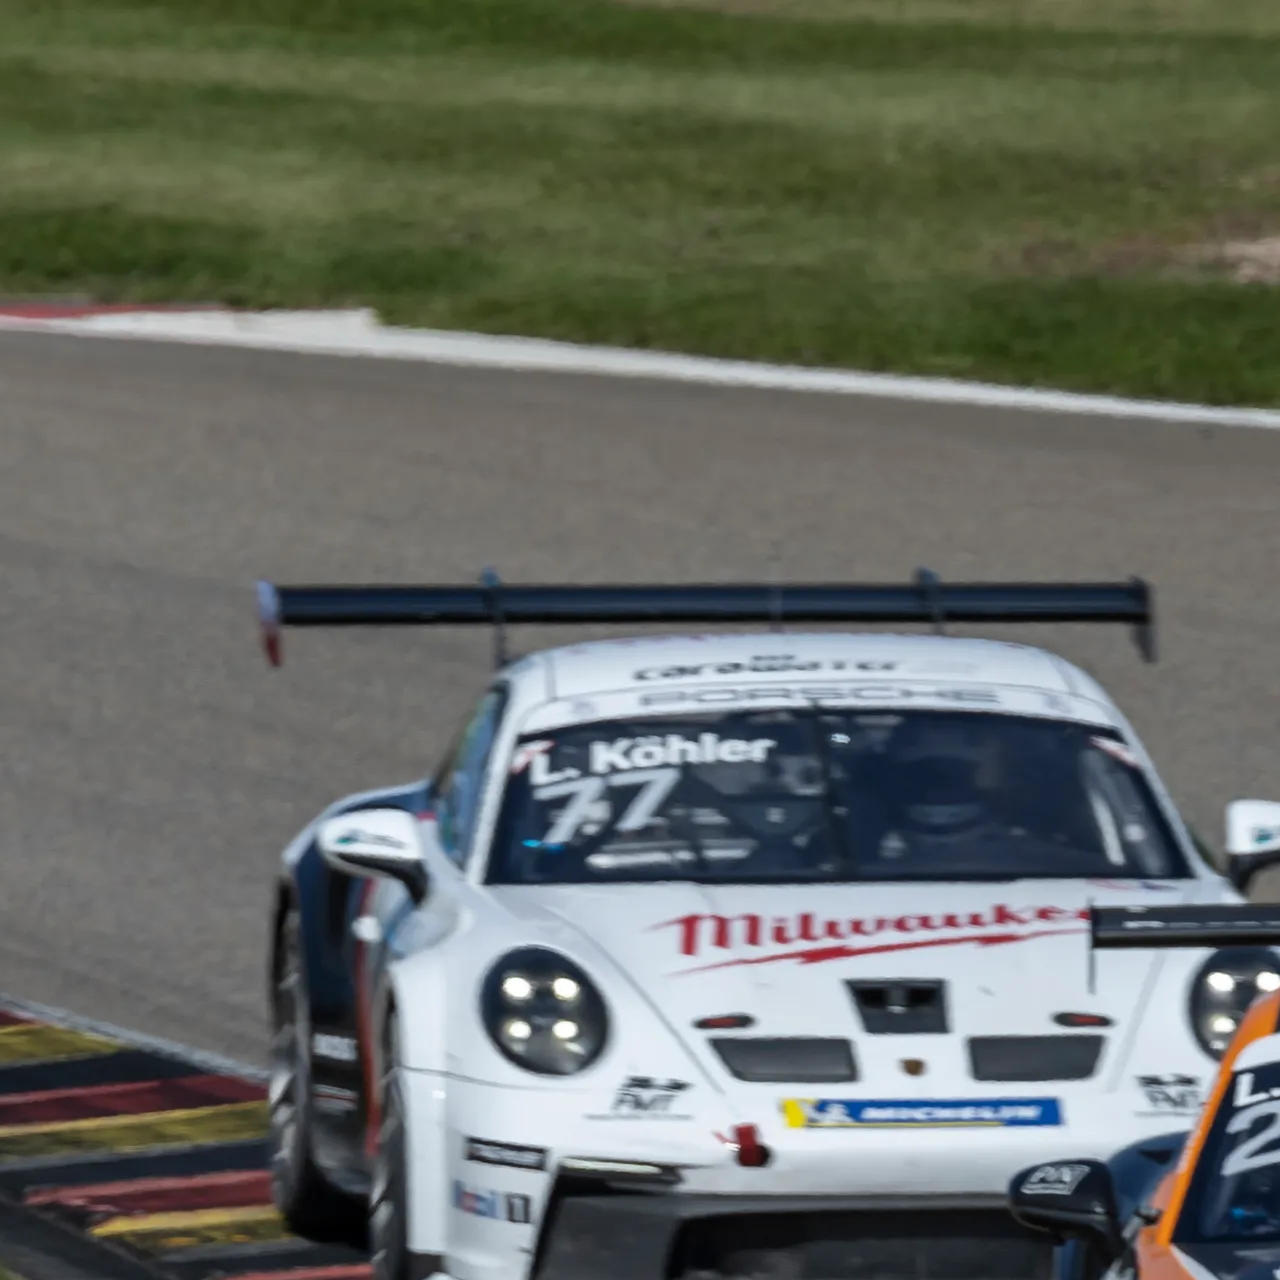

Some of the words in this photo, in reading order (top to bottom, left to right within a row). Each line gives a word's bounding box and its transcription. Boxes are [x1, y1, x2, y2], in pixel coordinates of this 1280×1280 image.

[638, 685, 1002, 707] PORSCHE
[528, 748, 580, 787] L.
[588, 732, 778, 774] Köhler
[533, 767, 681, 847] 77
